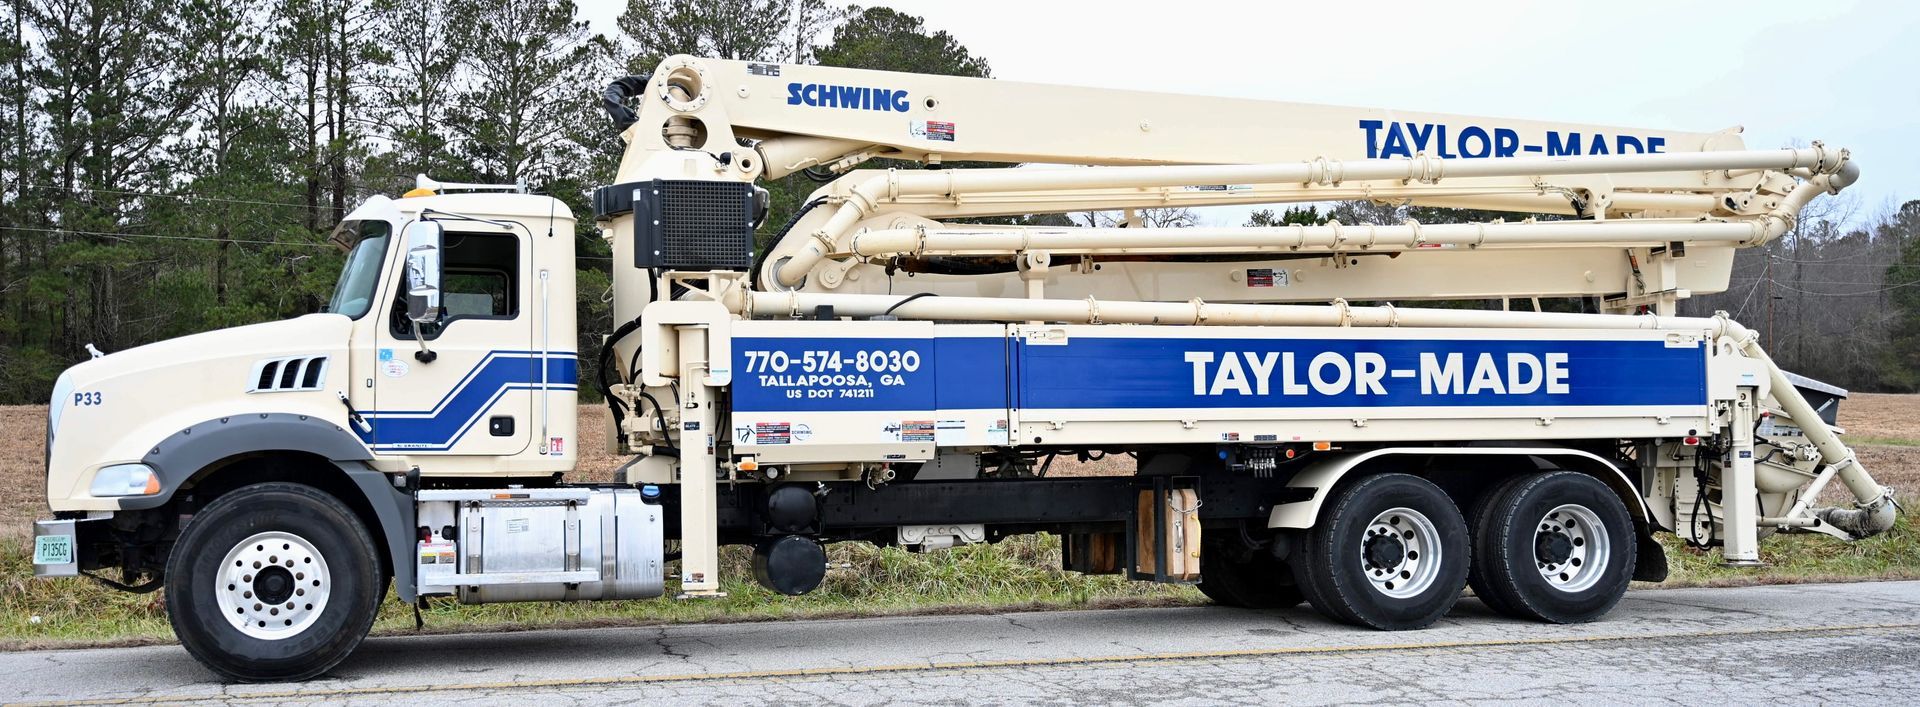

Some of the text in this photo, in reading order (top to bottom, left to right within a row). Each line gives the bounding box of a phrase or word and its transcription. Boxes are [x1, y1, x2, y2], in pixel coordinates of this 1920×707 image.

[788, 83, 910, 112] SCHWING
[745, 351, 920, 372] 770-574-8030
[759, 375, 905, 387] TALLAPOOSA, GA
[1185, 352, 1570, 395] TAYLOR-MADE
[75, 392, 101, 406] P33
[787, 389, 874, 398] US DOT 741211
